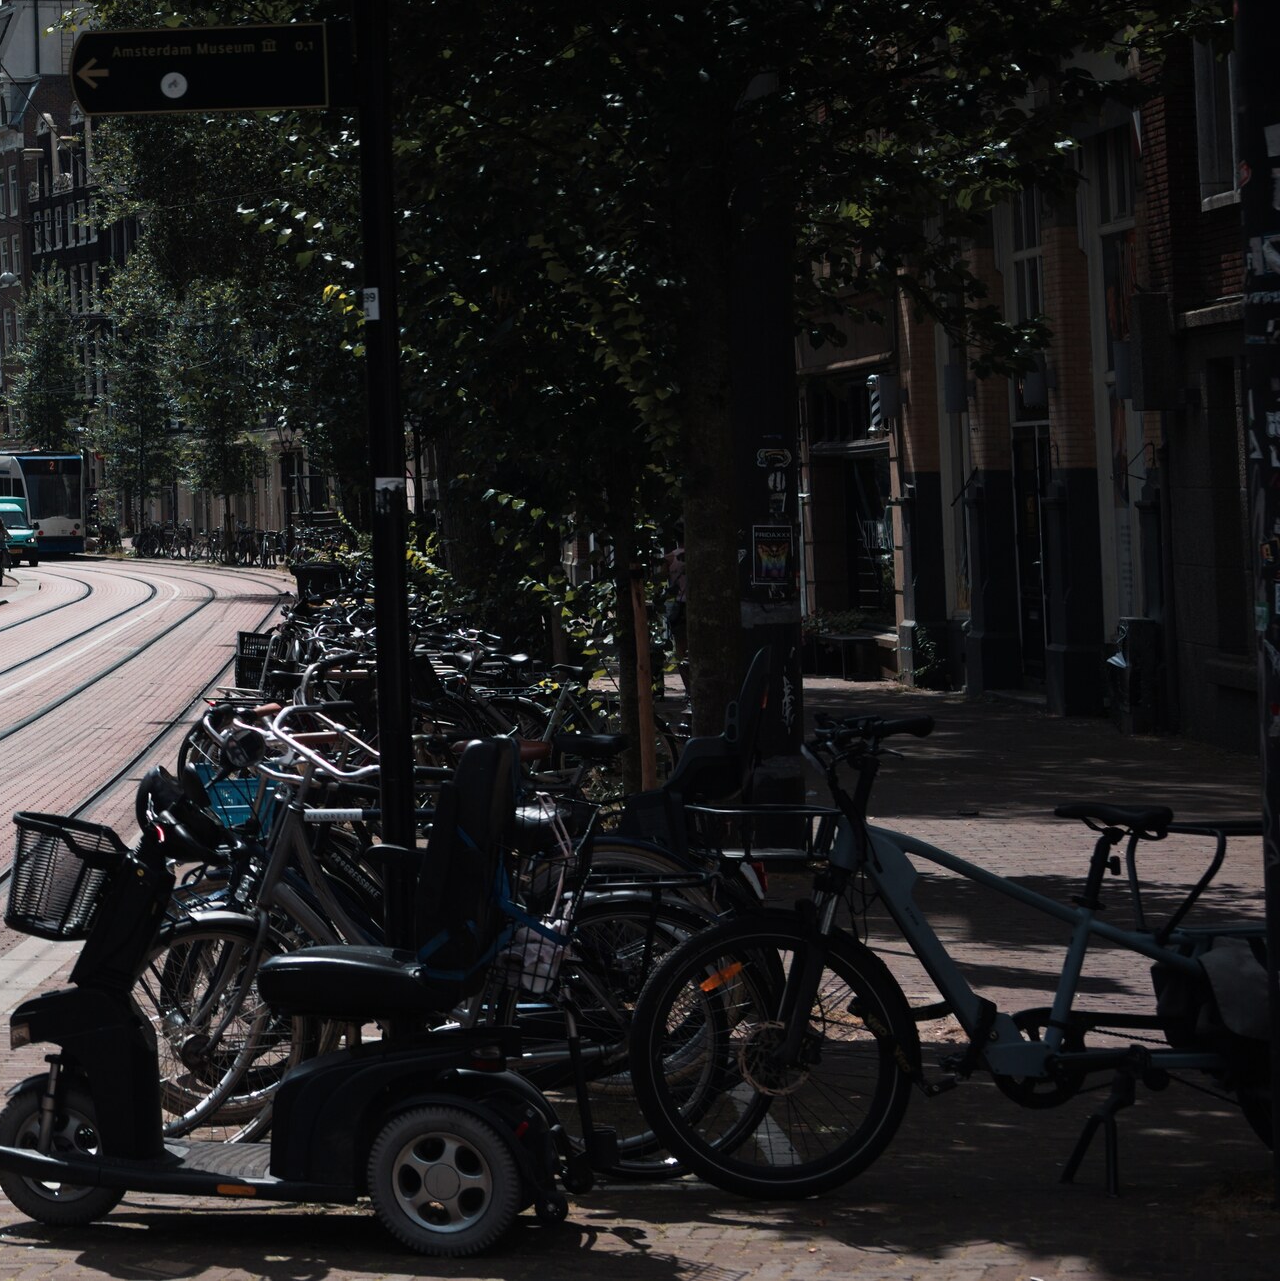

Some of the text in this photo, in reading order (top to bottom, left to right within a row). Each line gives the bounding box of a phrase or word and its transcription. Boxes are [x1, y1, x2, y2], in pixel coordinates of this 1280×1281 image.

[111, 44, 192, 59] Amsterdam
[196, 41, 256, 56] Museum
[49, 461, 55, 470] 2
